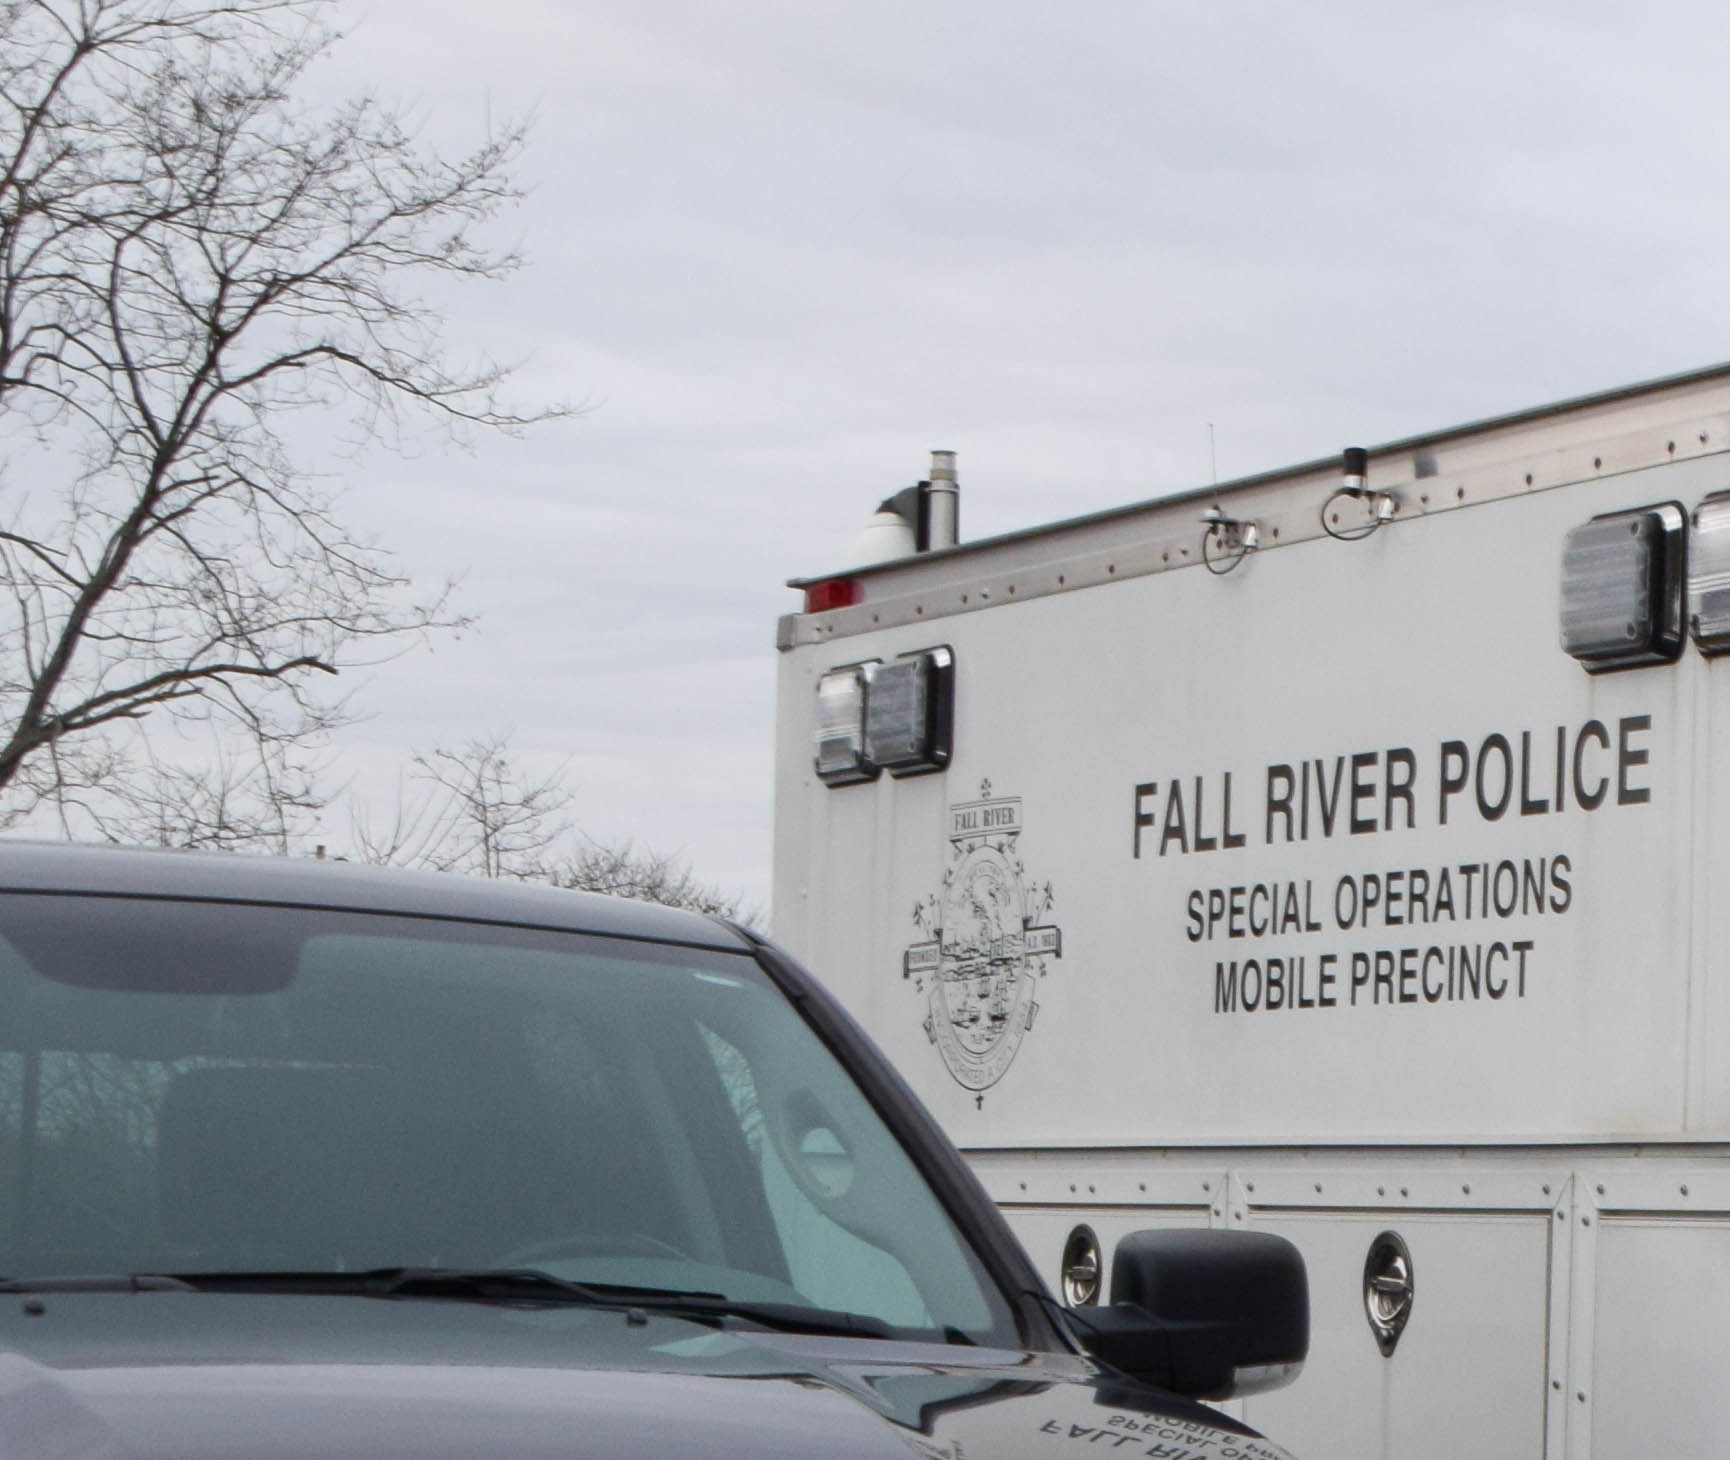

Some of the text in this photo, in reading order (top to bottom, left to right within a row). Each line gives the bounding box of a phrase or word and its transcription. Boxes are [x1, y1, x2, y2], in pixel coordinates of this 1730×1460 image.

[954, 806, 1015, 833] FALL RIVER
[1133, 715, 1652, 859] FALL RIVER POLICE
[1186, 854, 1573, 943] SPECIAL OPERATIONS
[1214, 941, 1534, 1015] MOBILE PRECINCT
